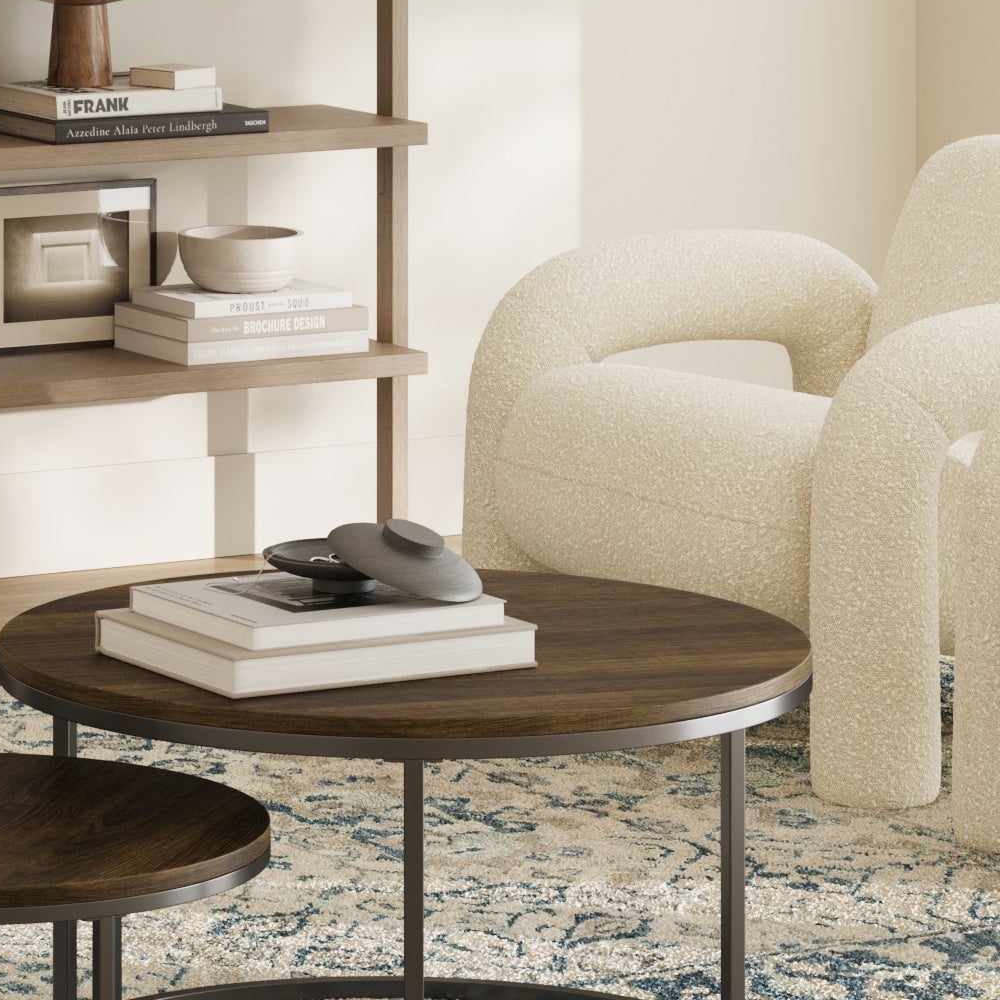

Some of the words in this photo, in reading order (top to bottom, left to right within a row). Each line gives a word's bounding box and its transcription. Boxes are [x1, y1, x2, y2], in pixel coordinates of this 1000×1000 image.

[73, 97, 129, 114] FRANK
[66, 126, 110, 139] Azzedine
[113, 124, 139, 136] Alaïa
[142, 124, 166, 134] Peter
[169, 119, 217, 133] Lindbergh
[229, 301, 265, 312] PROUST
[287, 297, 310, 308] SQUID
[243, 318, 291, 334] BROCHURE
[293, 315, 326, 331] DESIGN
